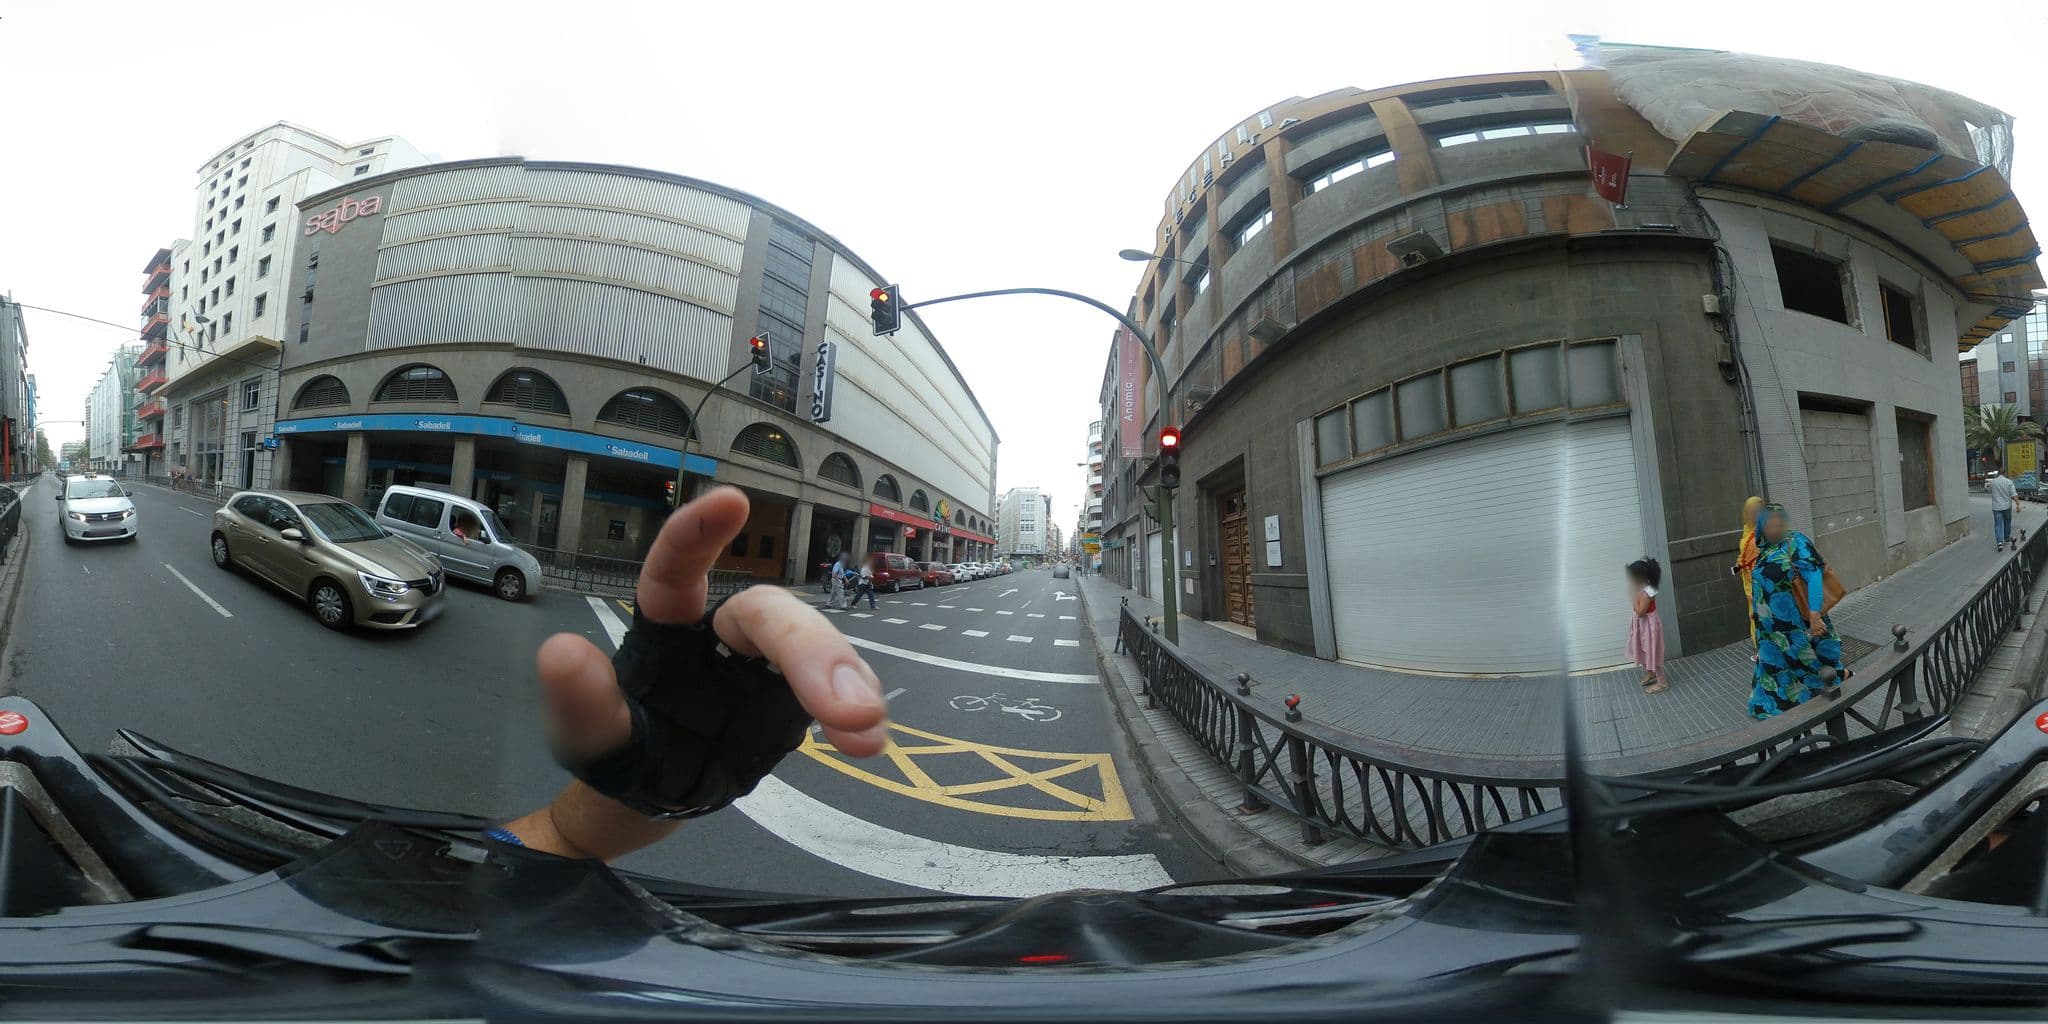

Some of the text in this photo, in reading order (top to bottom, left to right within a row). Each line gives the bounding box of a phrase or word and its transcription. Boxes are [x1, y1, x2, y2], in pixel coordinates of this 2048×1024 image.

[305, 195, 382, 235] saba
[811, 342, 828, 418] CASINO
[418, 420, 451, 430] Sabadell
[515, 432, 542, 443] abadell
[612, 445, 649, 461] Sabadell
